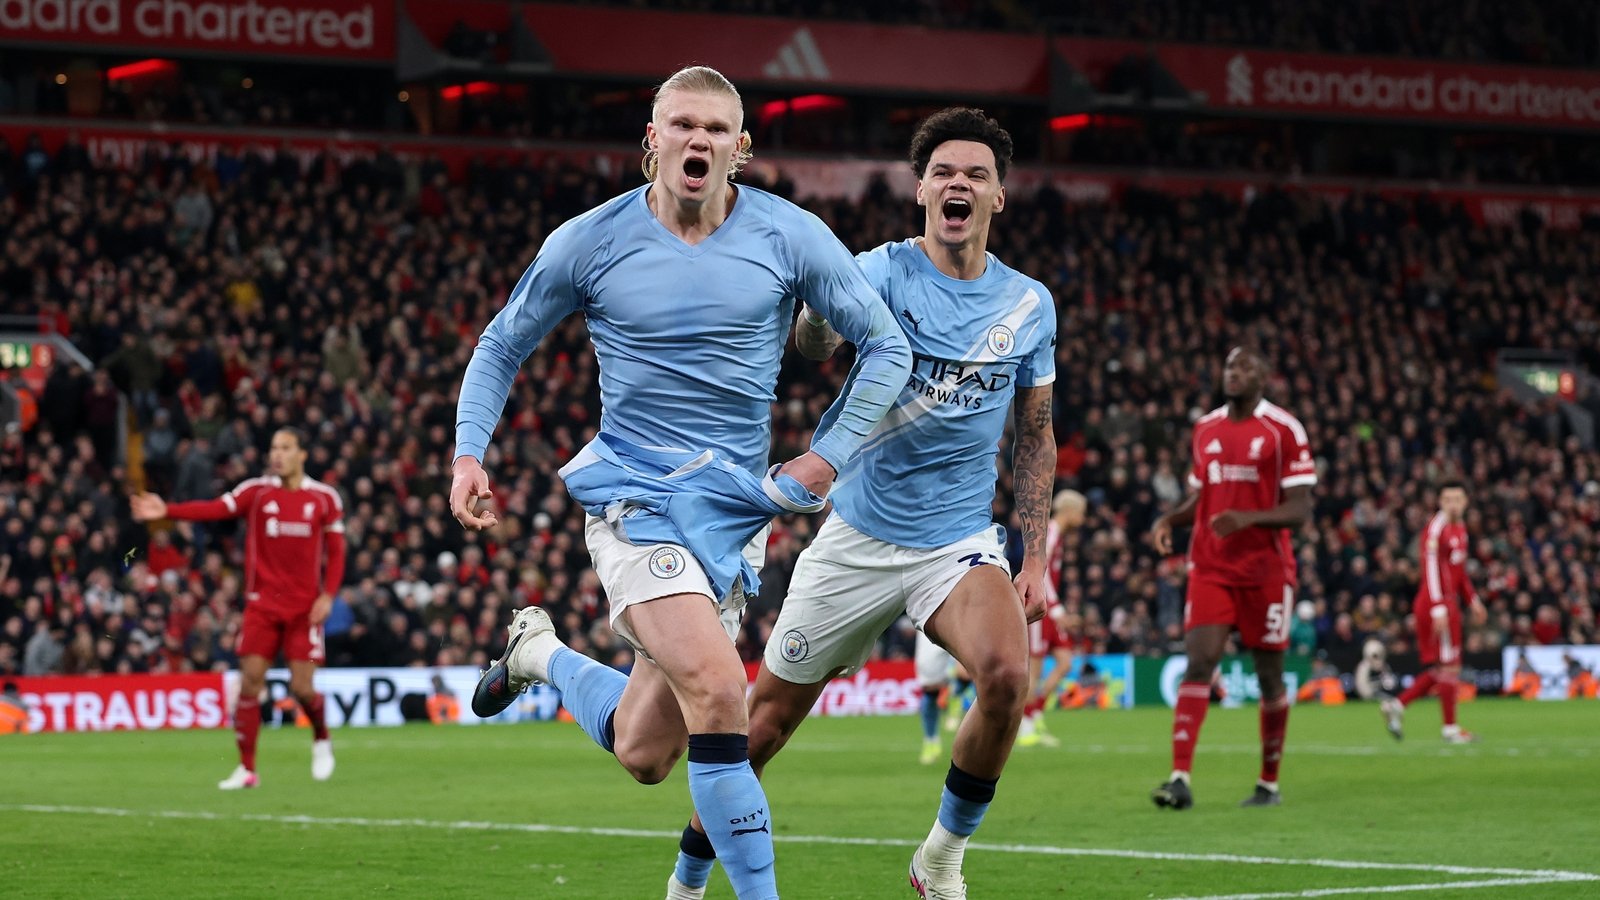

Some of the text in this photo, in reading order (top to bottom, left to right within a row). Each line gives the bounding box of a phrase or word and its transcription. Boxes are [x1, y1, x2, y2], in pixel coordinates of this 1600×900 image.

[133, 0, 374, 48] chartered
[1263, 67, 1435, 112] standard
[911, 355, 1011, 392] TIHAD
[906, 378, 983, 411] AIRWAYS
[1266, 603, 1283, 630] 5
[22, 688, 223, 733] STRAUSS
[730, 807, 763, 825] CITY
